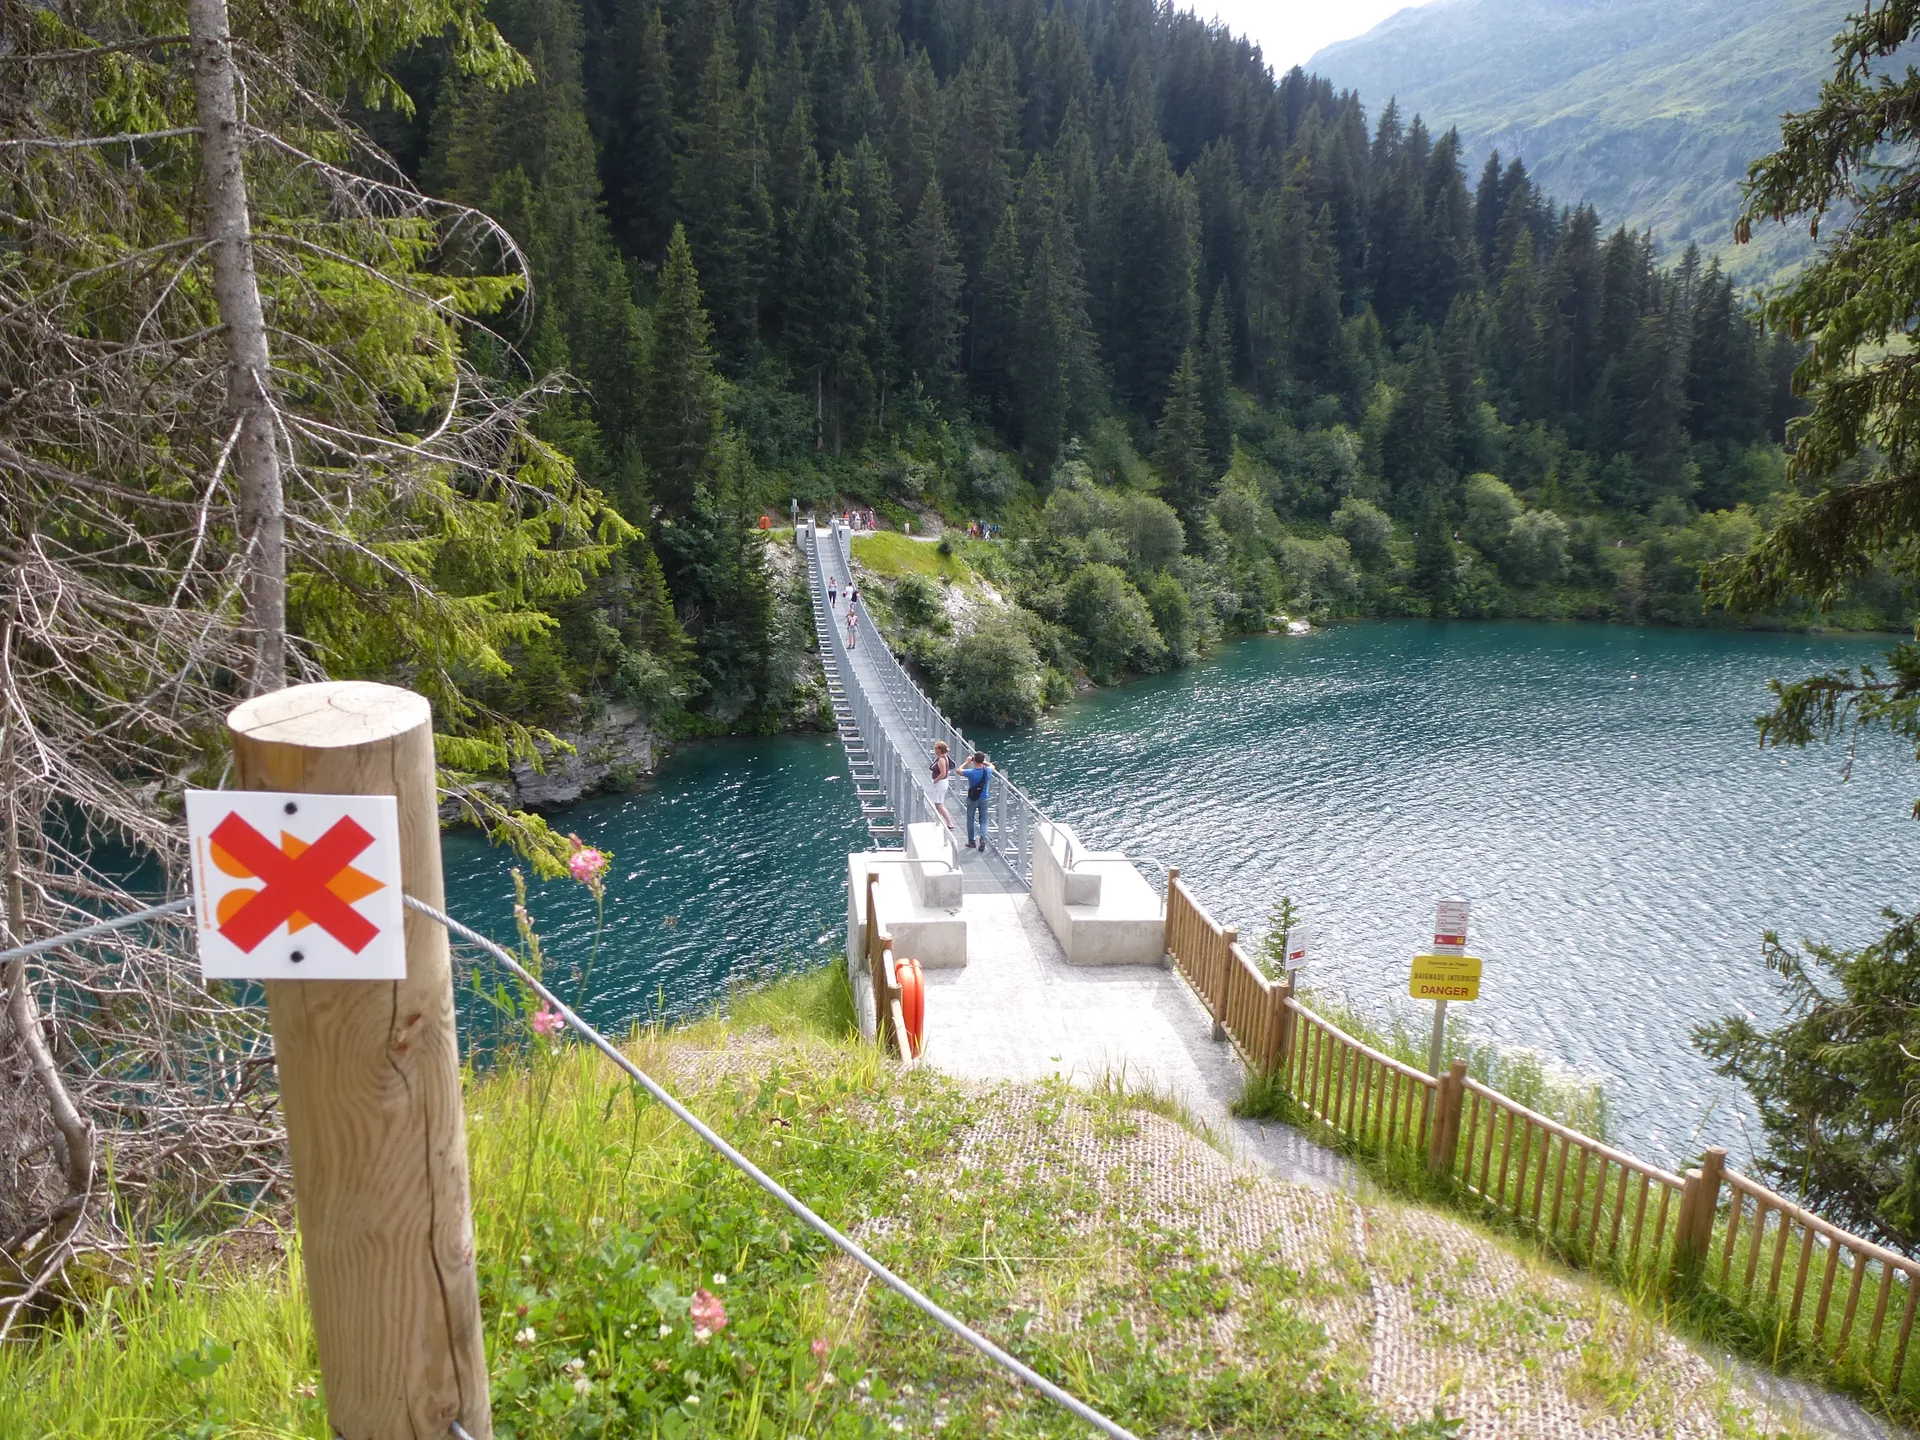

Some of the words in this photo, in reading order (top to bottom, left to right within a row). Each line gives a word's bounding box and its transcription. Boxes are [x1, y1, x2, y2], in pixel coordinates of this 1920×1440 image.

[1414, 972, 1445, 981] BAIGNADE
[1447, 974, 1479, 983] INTERDITE
[1420, 985, 1469, 996] DANGER
